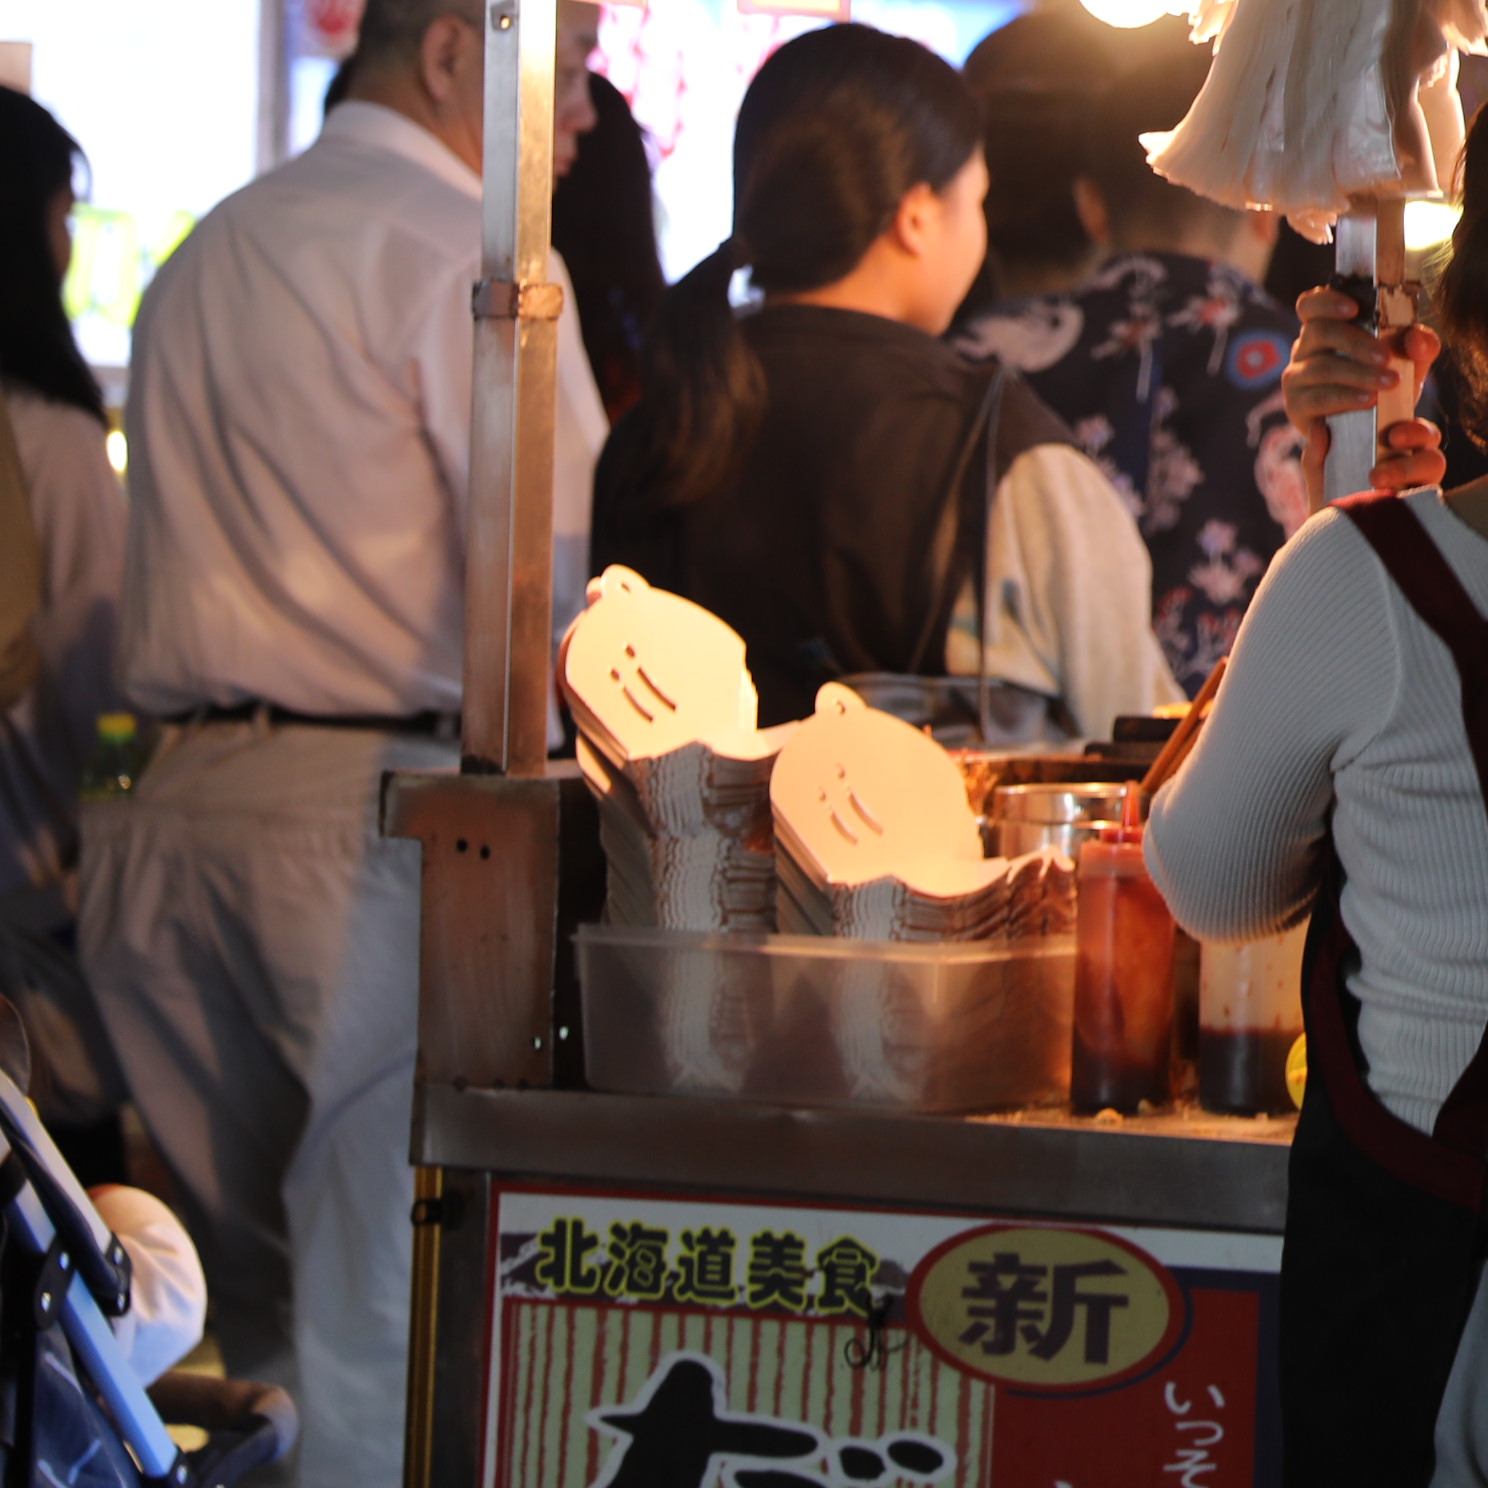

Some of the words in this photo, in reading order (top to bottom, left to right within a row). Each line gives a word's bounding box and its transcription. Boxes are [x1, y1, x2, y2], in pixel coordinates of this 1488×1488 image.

[534, 1218, 880, 1315] 北海道美食
[960, 1252, 1129, 1365] 新
